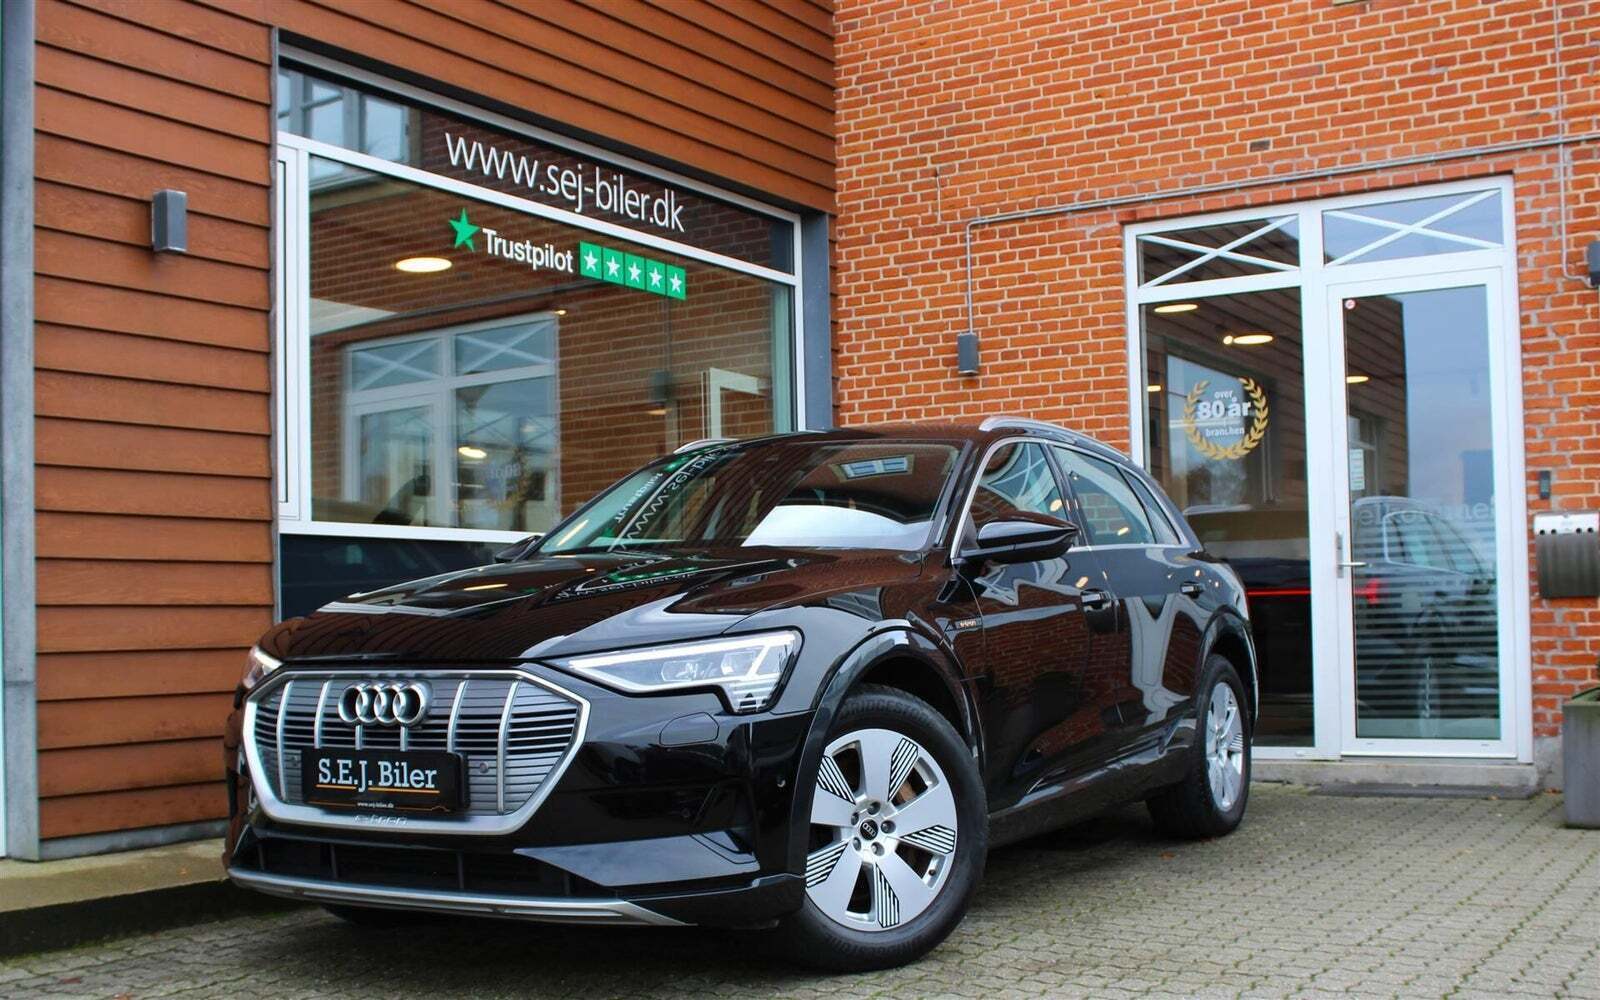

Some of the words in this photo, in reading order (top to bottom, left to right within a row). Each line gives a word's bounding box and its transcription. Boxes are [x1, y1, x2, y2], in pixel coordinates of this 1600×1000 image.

[445, 132, 685, 232] www.sej-biler.dk
[482, 228, 574, 273] Trustpilot
[1198, 399, 1225, 421] 80
[1227, 396, 1252, 417] år
[1213, 390, 1233, 400] over
[318, 758, 373, 793] S.E.J.
[378, 761, 437, 789] Biler
